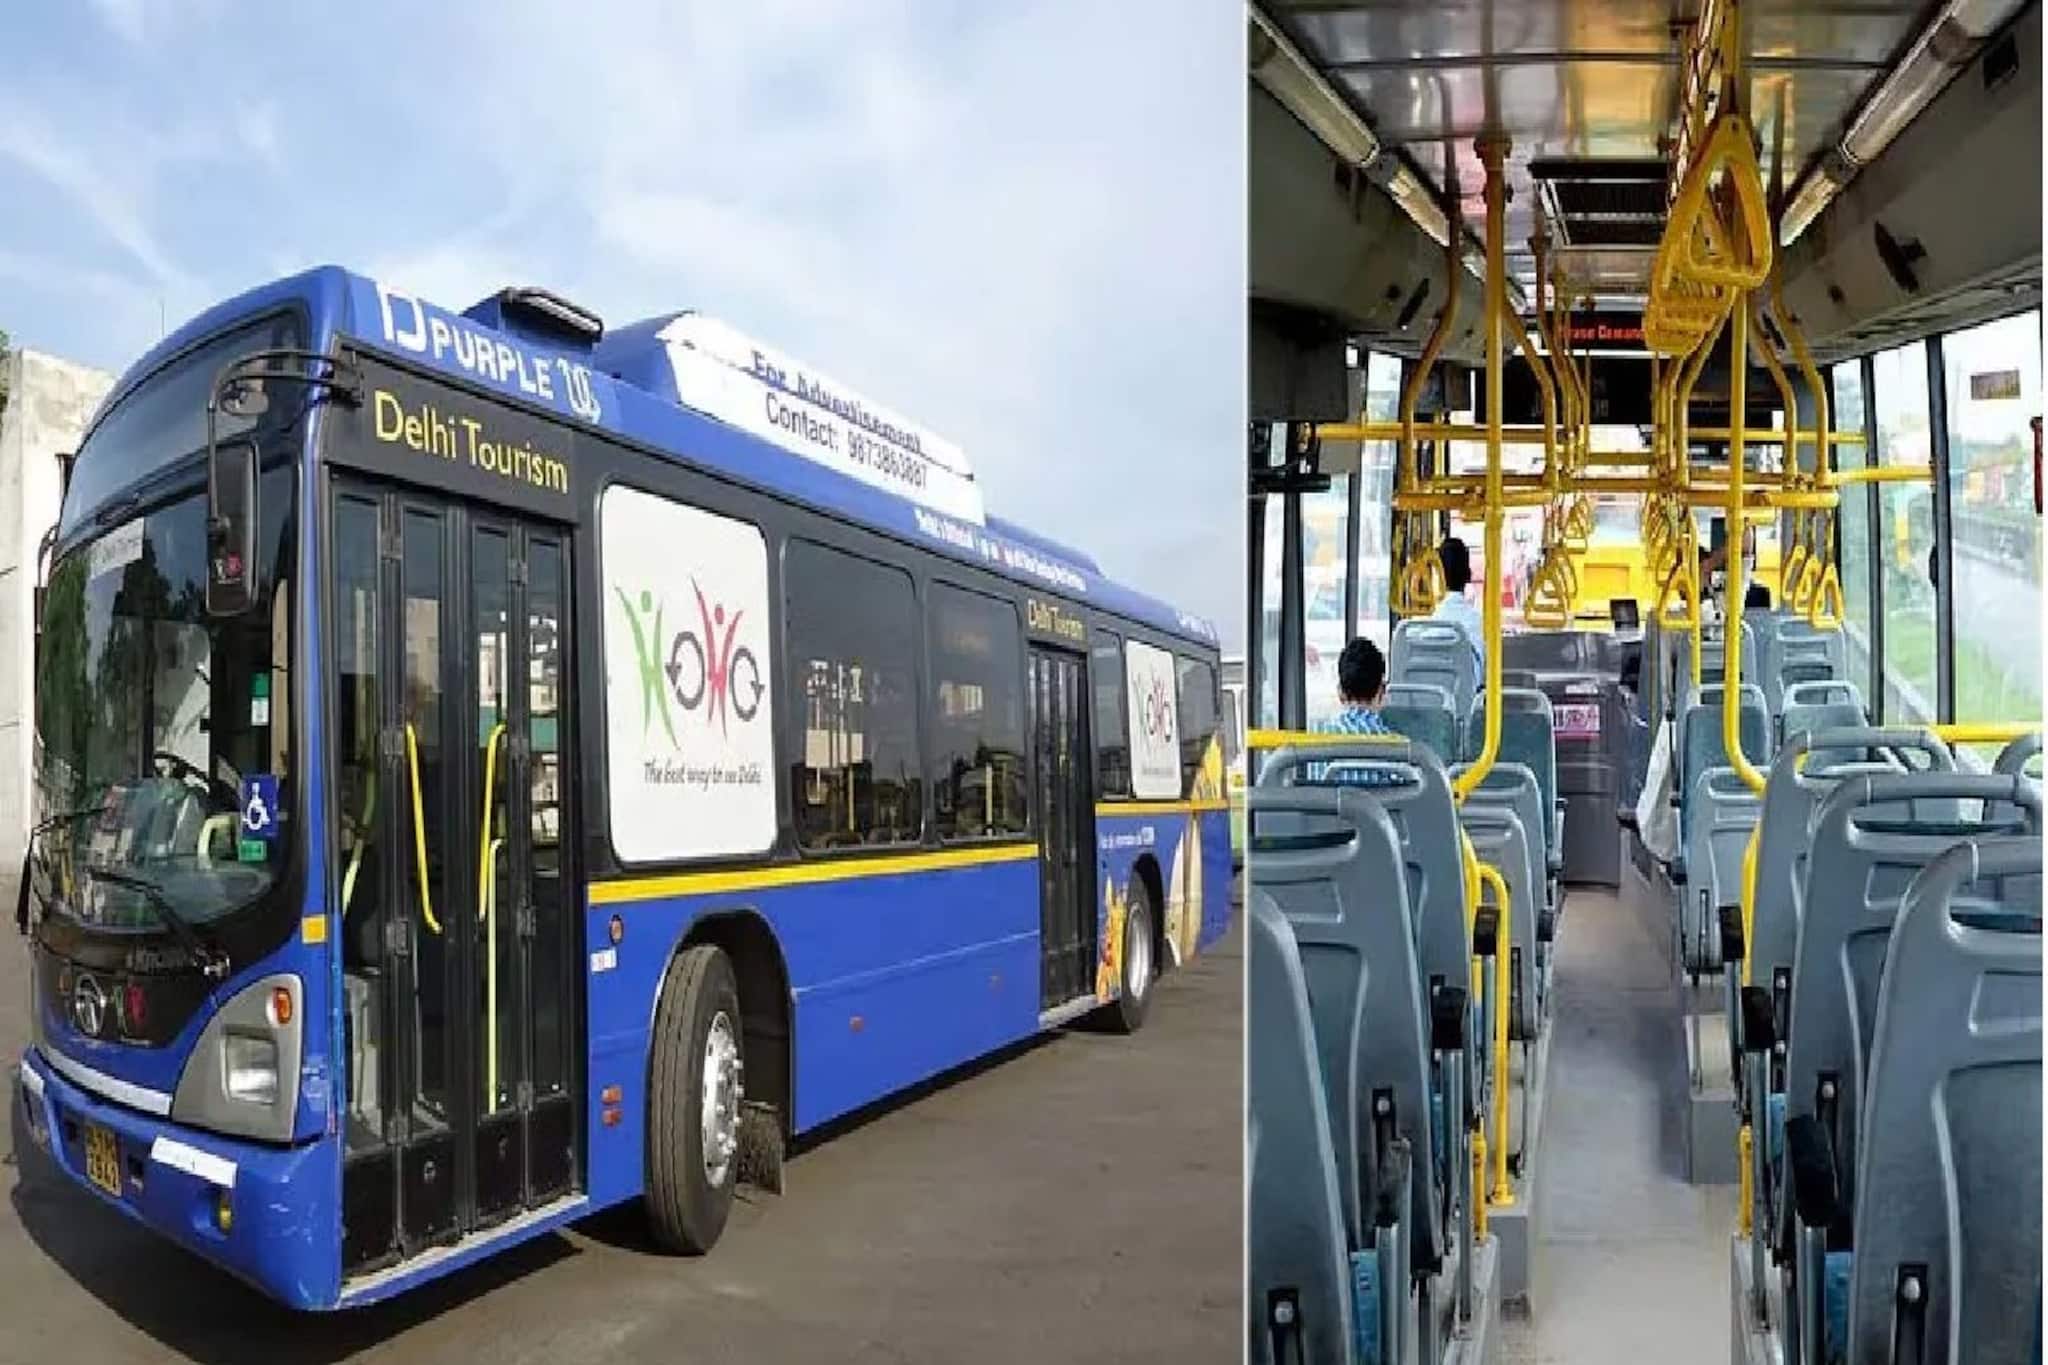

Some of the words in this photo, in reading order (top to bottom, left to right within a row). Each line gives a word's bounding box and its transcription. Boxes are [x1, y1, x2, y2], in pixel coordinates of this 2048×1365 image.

[431, 317, 554, 400] PURPLE
[374, 390, 457, 462] Delhi
[462, 419, 568, 495] Tourism
